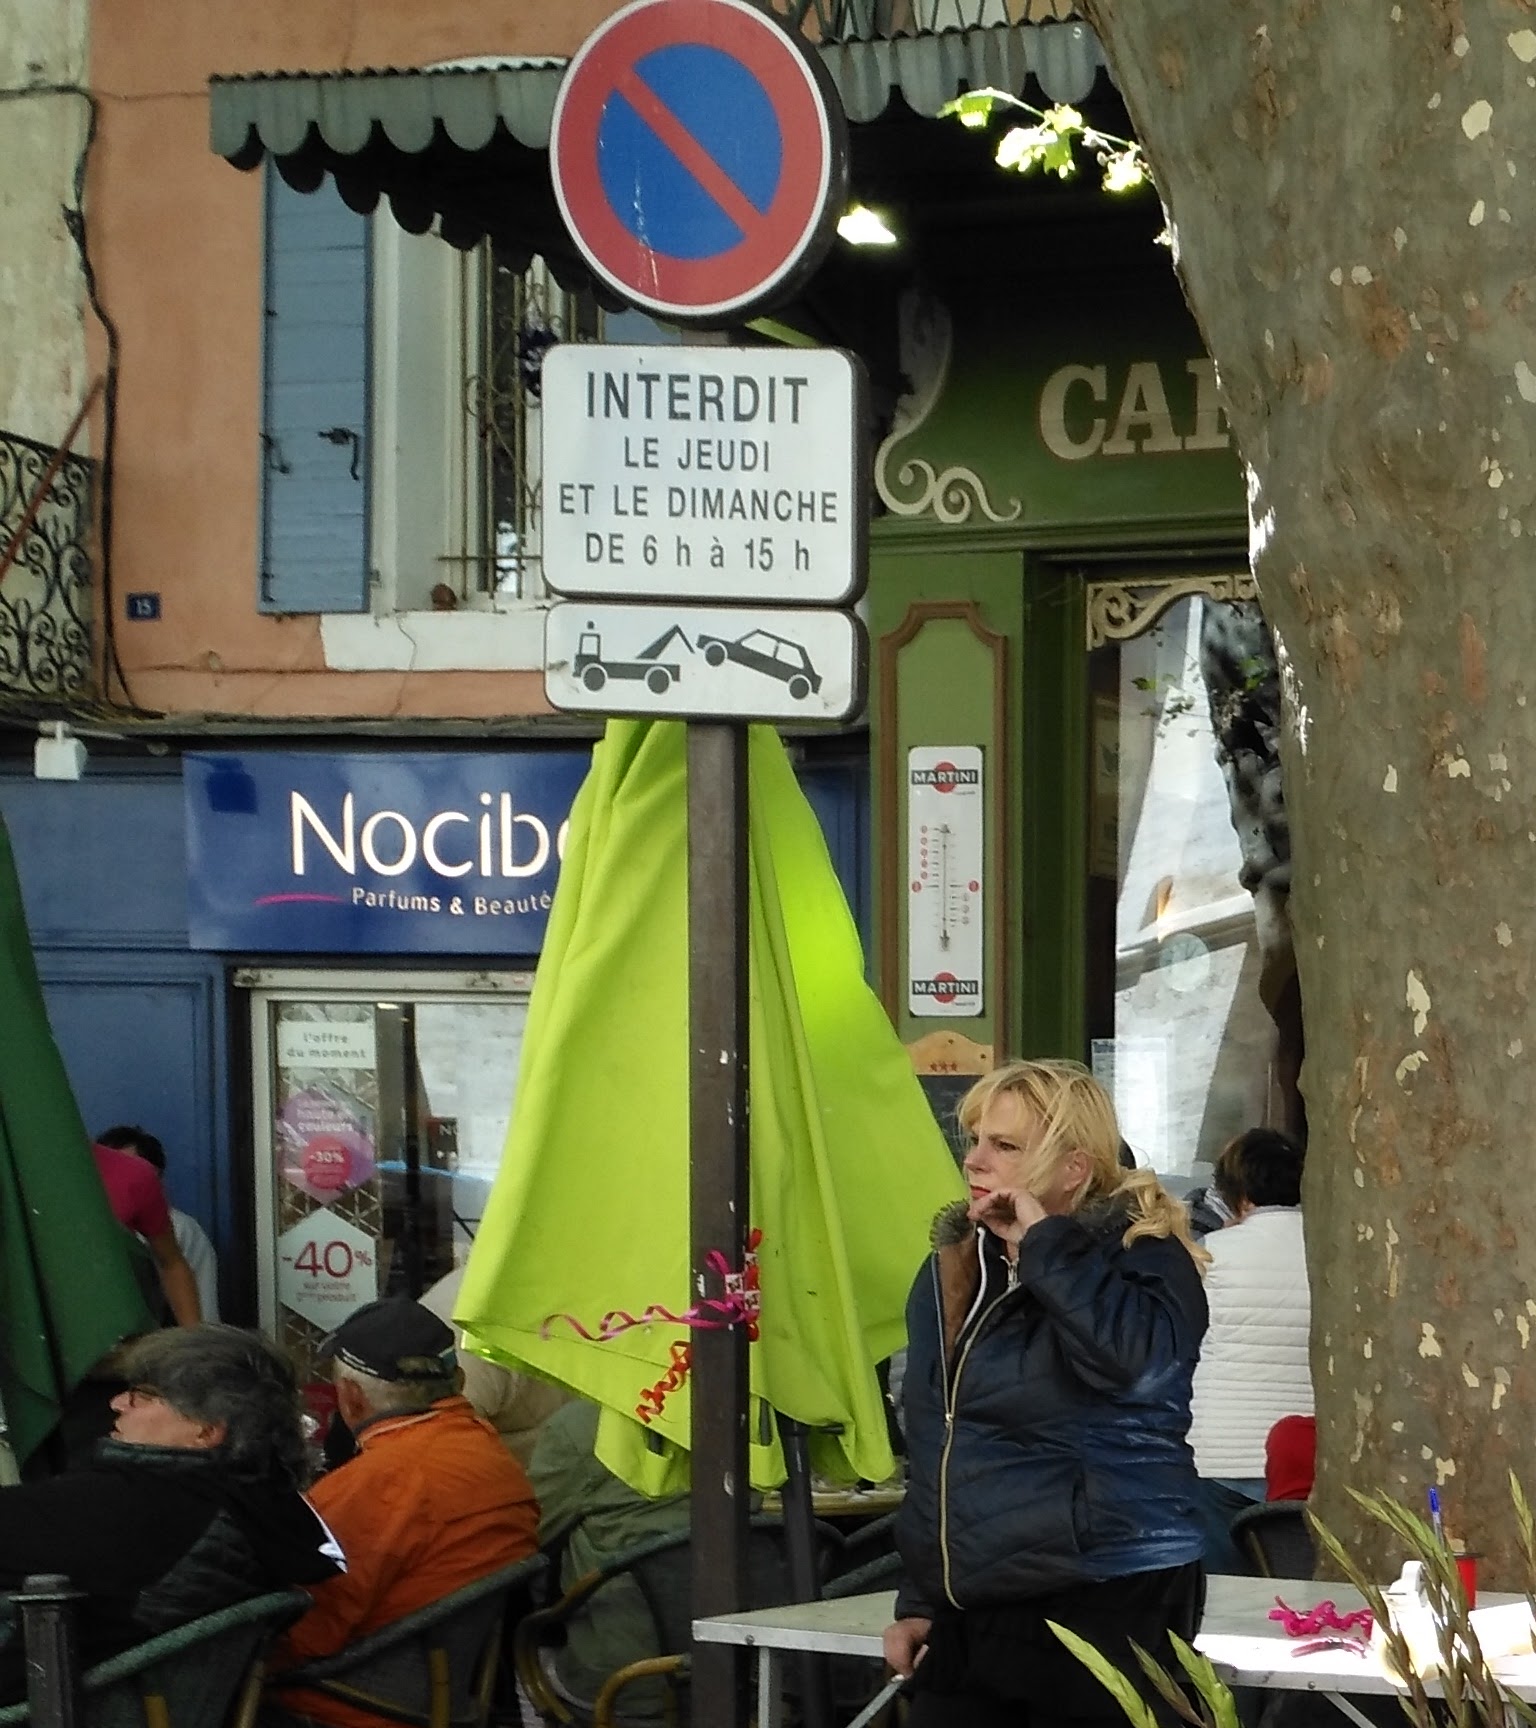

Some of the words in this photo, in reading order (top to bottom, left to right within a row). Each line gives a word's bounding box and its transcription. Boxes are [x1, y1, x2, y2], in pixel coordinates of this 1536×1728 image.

[586, 371, 809, 425] INTERDIT
[624, 436, 660, 469] LE
[677, 439, 770, 473] JEUDI
[559, 483, 595, 515] ET
[613, 485, 649, 517] LE
[667, 487, 838, 524] DIMANCHE
[585, 532, 625, 565] DE
[643, 534, 658, 566] 6
[676, 536, 692, 568] h
[709, 536, 725, 569] à
[745, 537, 774, 572] 15
[795, 539, 810, 572] h
[913, 771, 977, 784] MARTINI
[352, 887, 441, 914] Parfums
[449, 896, 465, 916] &
[474, 890, 552, 916] Beauté
[914, 981, 978, 995] MARTINI
[281, 1241, 373, 1278] -40%
